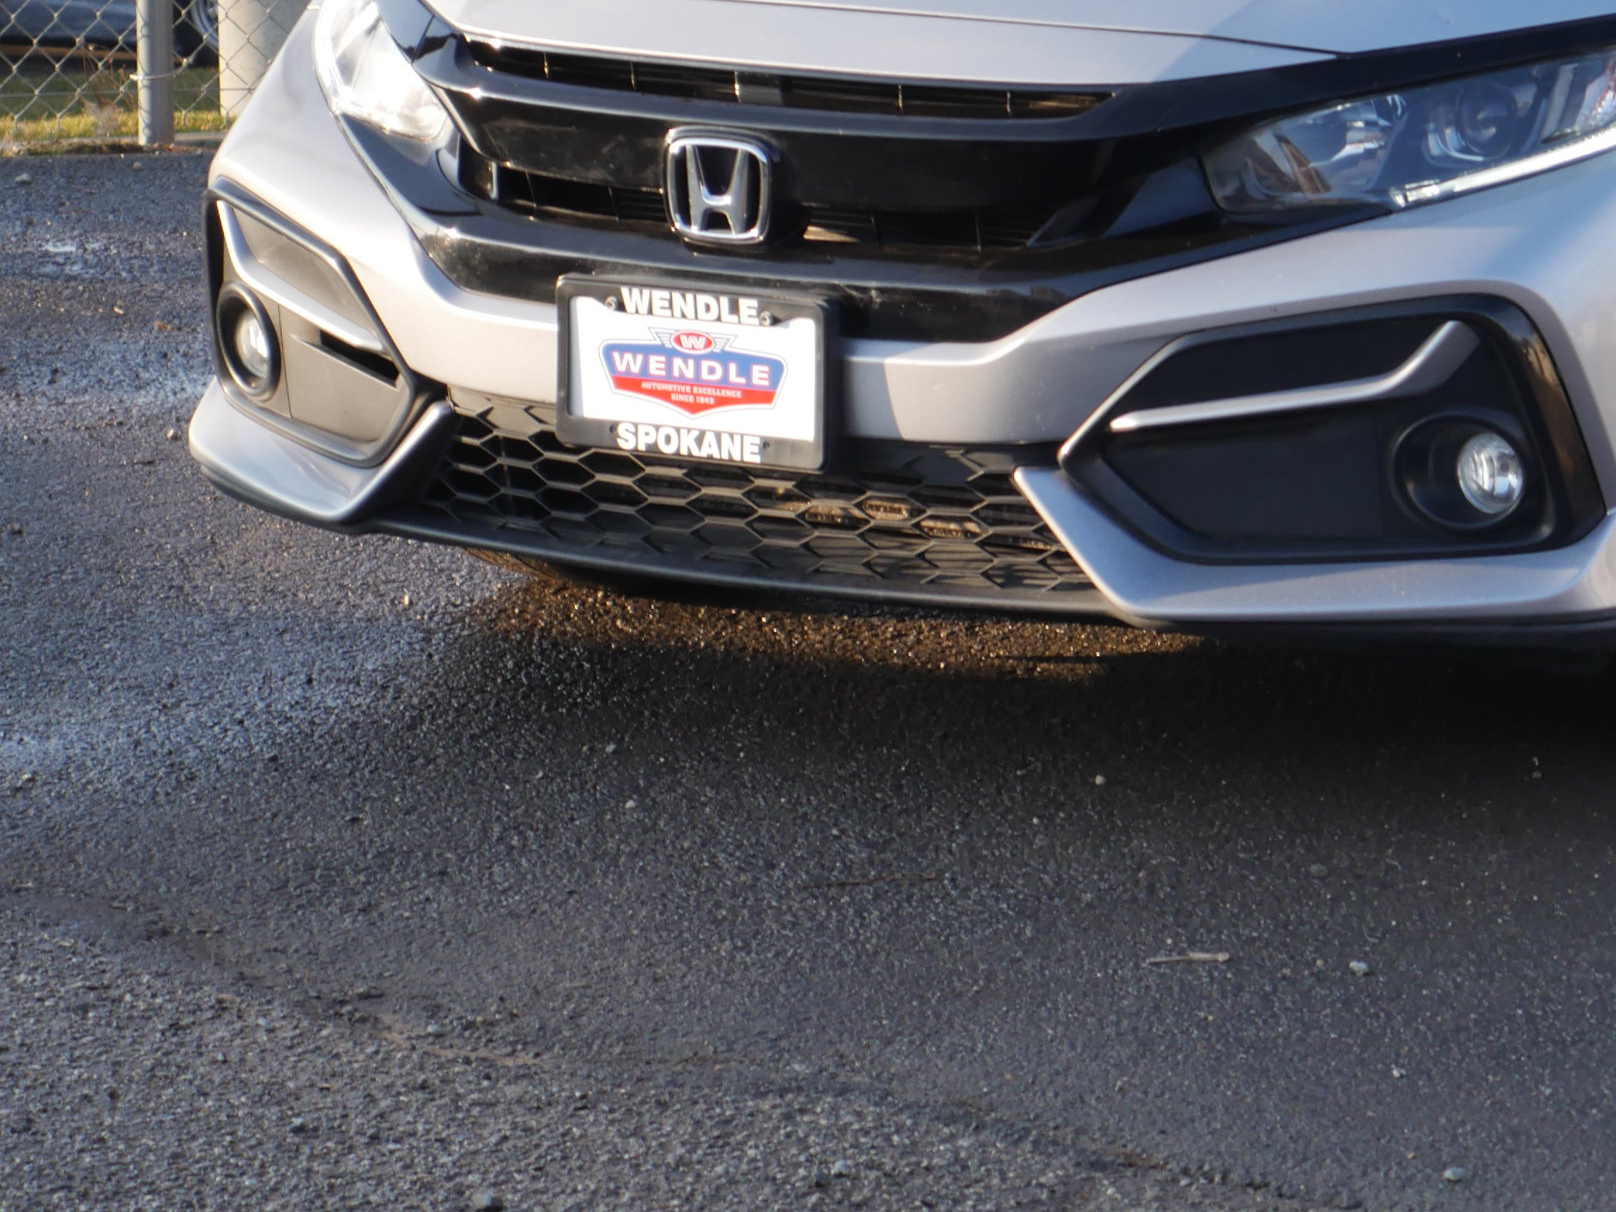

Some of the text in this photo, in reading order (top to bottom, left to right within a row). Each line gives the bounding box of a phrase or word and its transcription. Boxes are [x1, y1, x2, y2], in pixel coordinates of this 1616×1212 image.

[620, 286, 760, 326] WENDLE
[679, 334, 707, 350] W
[612, 351, 770, 386] WENDLE
[641, 380, 742, 399] AUTOMOTIVE EXCELLENCE
[670, 393, 695, 404] SINCE
[616, 421, 762, 464] SPOKANE
